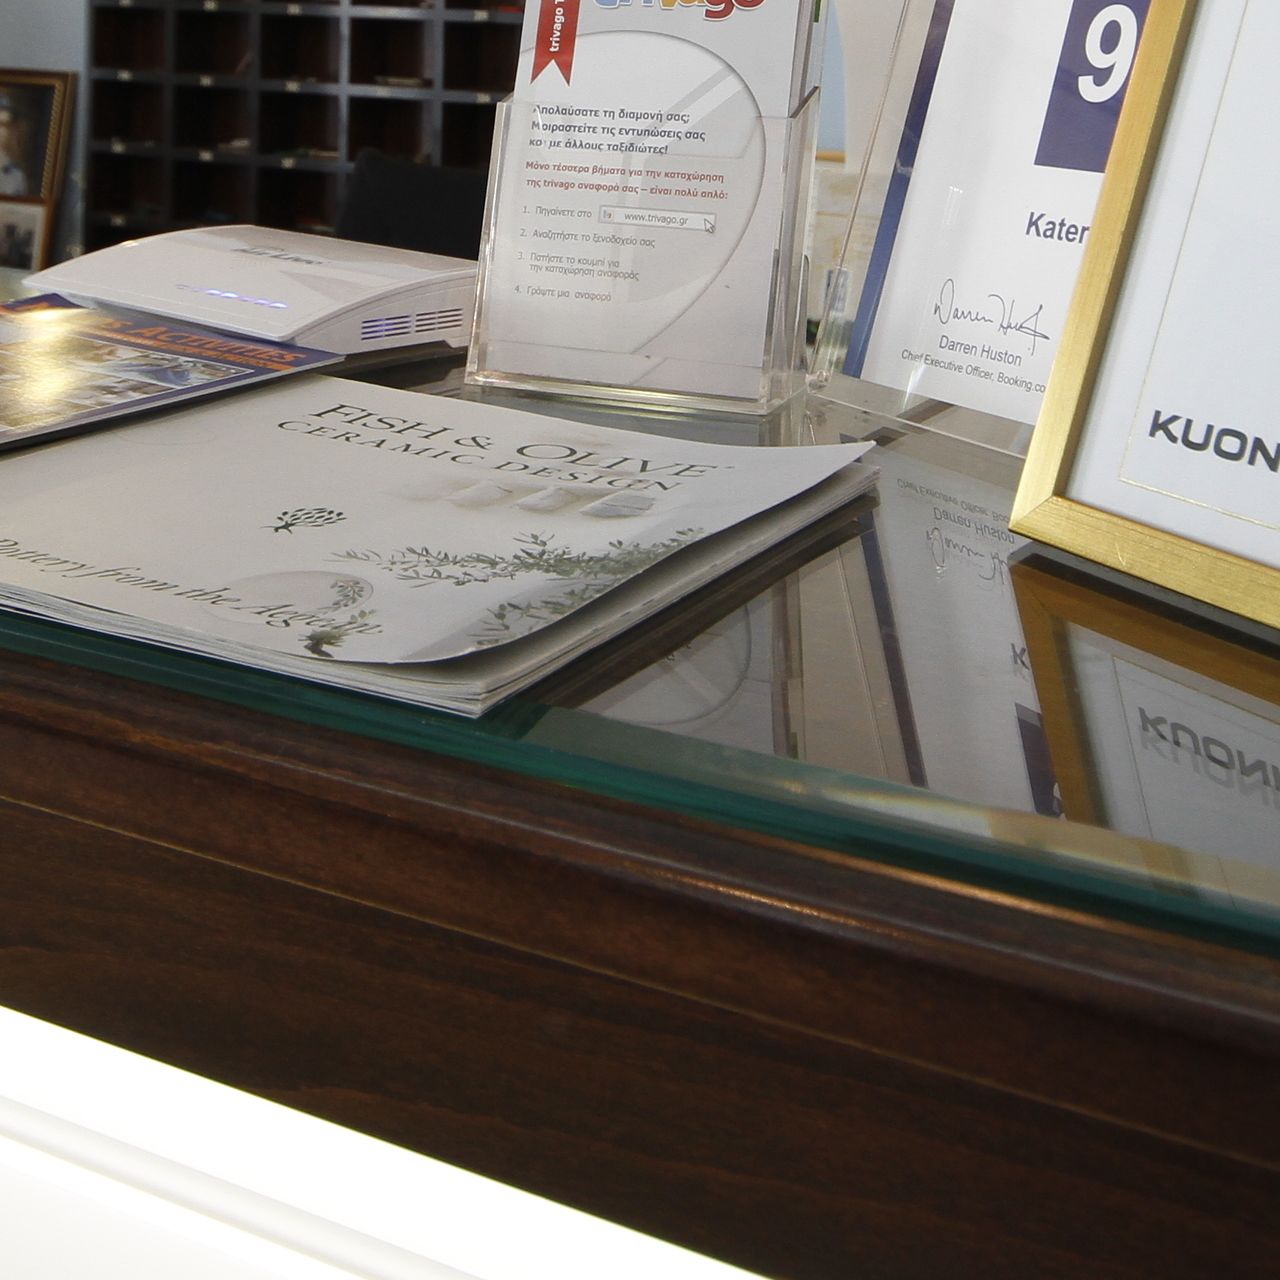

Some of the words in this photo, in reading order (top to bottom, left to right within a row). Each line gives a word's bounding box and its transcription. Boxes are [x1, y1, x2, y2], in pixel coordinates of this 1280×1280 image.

[549, 6, 565, 52] trivago
[603, 109, 615, 120] τη
[618, 108, 663, 123] διαμονή
[666, 112, 690, 124] σας;
[531, 120, 598, 134] Μοιραστείτε
[601, 125, 615, 136] τις
[618, 126, 682, 141] εντυπώσεις
[684, 130, 706, 141] σας
[529, 138, 547, 147] κα
[548, 139, 562, 150] με
[565, 138, 605, 152] άλλους
[607, 141, 668, 155] ταξιδιώτες!
[526, 160, 550, 171] Μόνο
[552, 162, 590, 174] τέσσερα
[591, 165, 625, 176] βήματα
[628, 168, 642, 178] για
[645, 168, 661, 179] την
[664, 170, 724, 184] καταχώρηση
[526, 178, 542, 189] της
[543, 179, 576, 192] trivago
[577, 181, 620, 193] αναφορά
[621, 184, 639, 195] σας
[674, 187, 698, 198] πολύ
[624, 212, 689, 226] www.trivago.gr
[939, 334, 978, 357] Darren
[980, 344, 1023, 367] Huston
[901, 349, 924, 362] Chief
[924, 354, 964, 373] Executive
[965, 364, 995, 382] Officer,
[308, 403, 454, 441] FISH
[453, 433, 496, 451] &
[515, 442, 719, 479] OLIVE
[275, 420, 486, 465] CERAMIC
[493, 460, 684, 492] DESIGN
[76, 565, 179, 592] from
[173, 585, 241, 606] the
